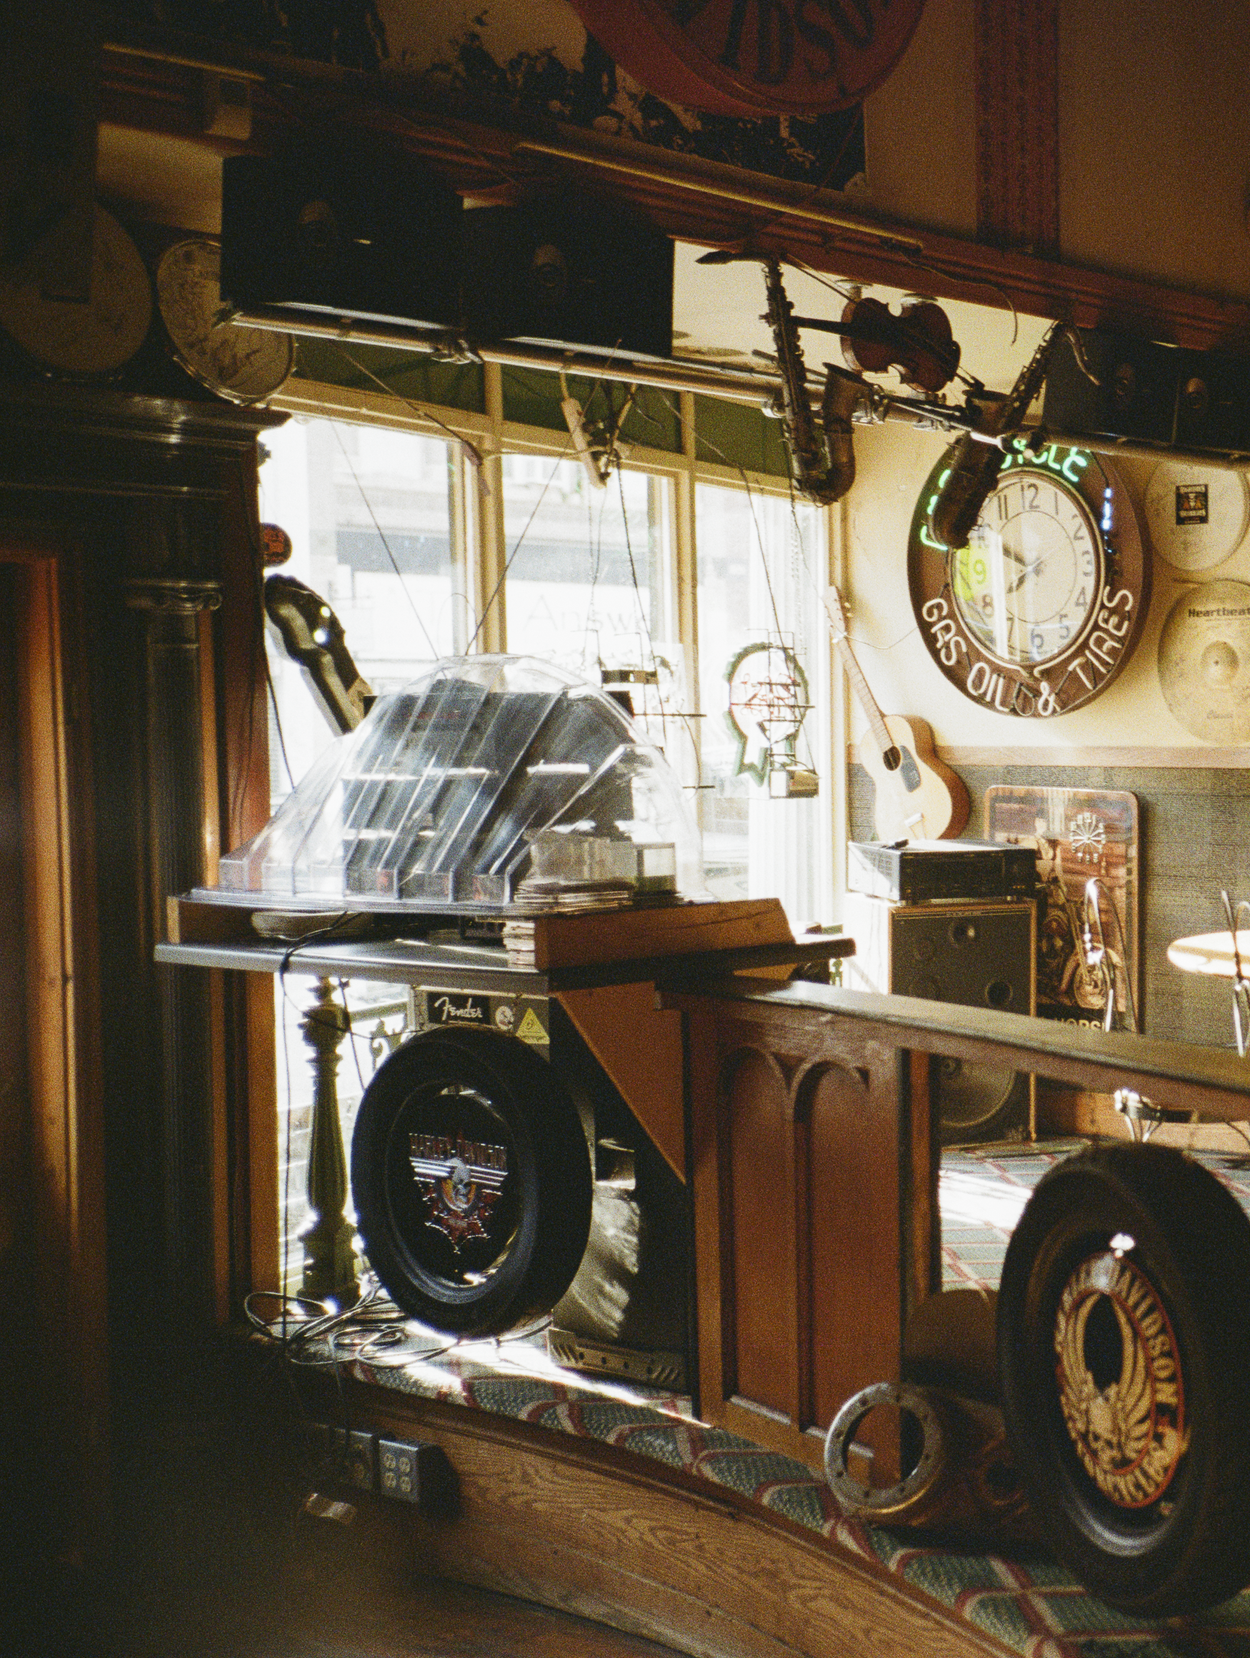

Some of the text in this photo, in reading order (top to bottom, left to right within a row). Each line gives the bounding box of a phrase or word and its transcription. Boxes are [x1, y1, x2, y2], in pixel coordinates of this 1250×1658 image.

[1020, 483, 1040, 510] 12
[972, 559, 987, 584] 9
[1081, 549, 1094, 578] 3
[1075, 586, 1088, 610] 4
[1030, 625, 1044, 650] 6
[922, 585, 1134, 717] GAS OIL & TIRES
[434, 996, 483, 1021] Fender
